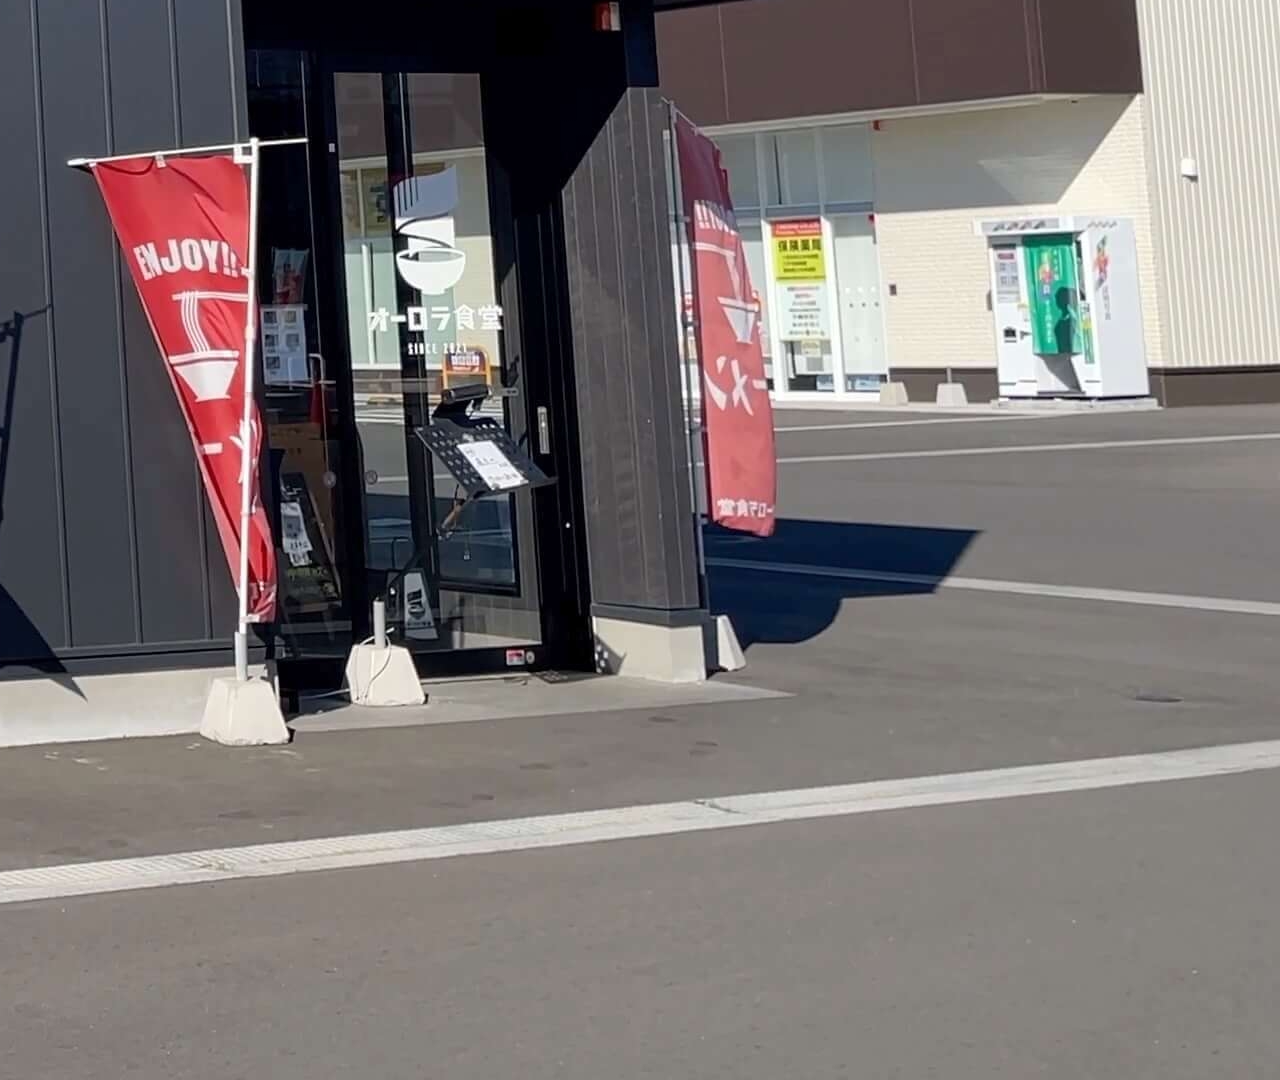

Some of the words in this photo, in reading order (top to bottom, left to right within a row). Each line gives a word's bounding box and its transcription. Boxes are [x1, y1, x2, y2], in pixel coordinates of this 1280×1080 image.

[133, 238, 239, 281] ENJOY!!
[367, 303, 503, 332] オーロラ食堂
